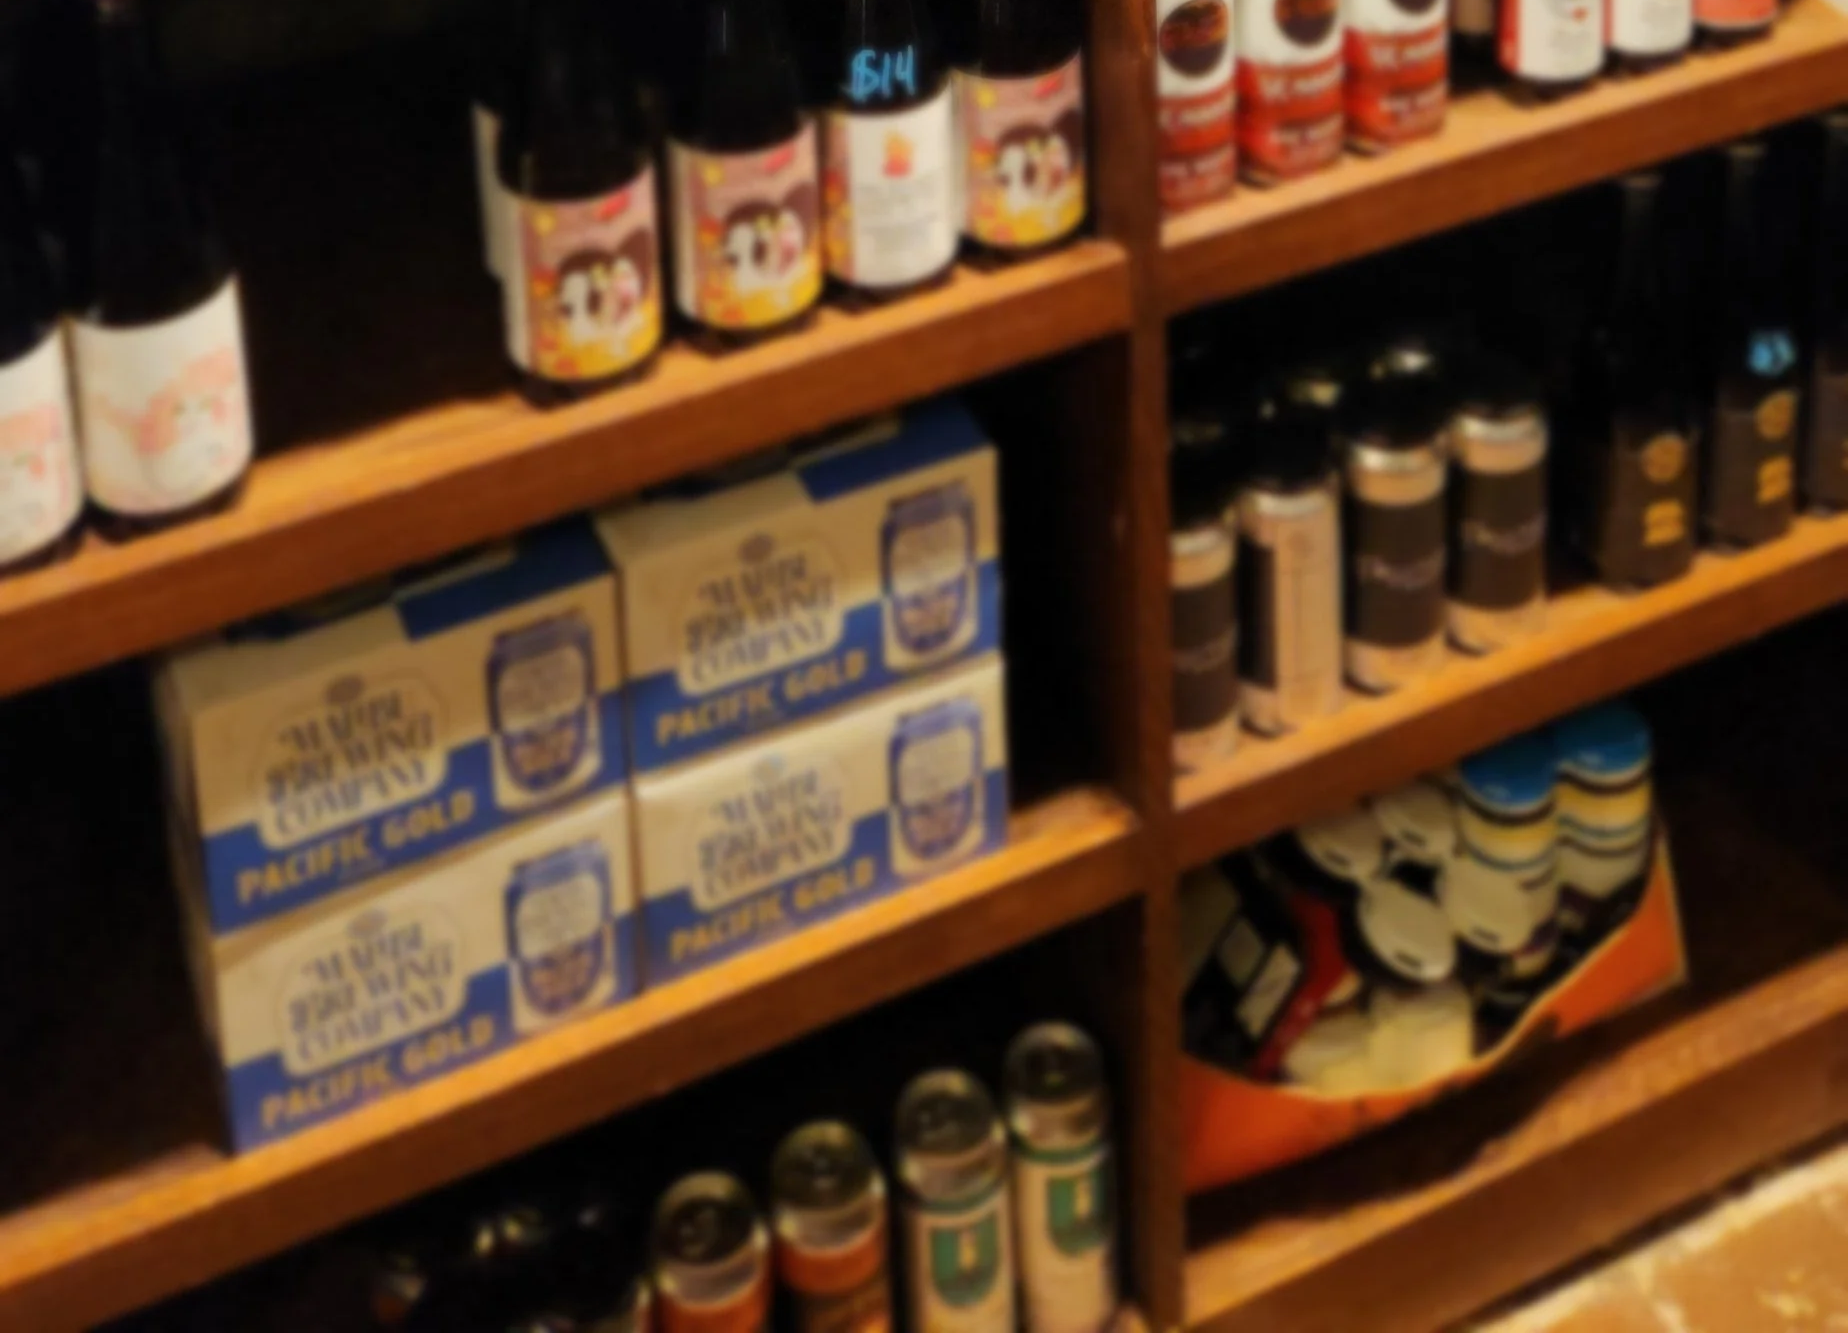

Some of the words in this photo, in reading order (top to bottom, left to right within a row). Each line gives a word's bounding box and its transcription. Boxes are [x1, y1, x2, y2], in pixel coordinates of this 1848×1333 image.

[846, 44, 916, 103] $14
[783, 649, 868, 704] GOLD
[382, 788, 476, 851] GOLD
[793, 856, 874, 911] GOLD
[402, 1013, 495, 1075] GOLD
